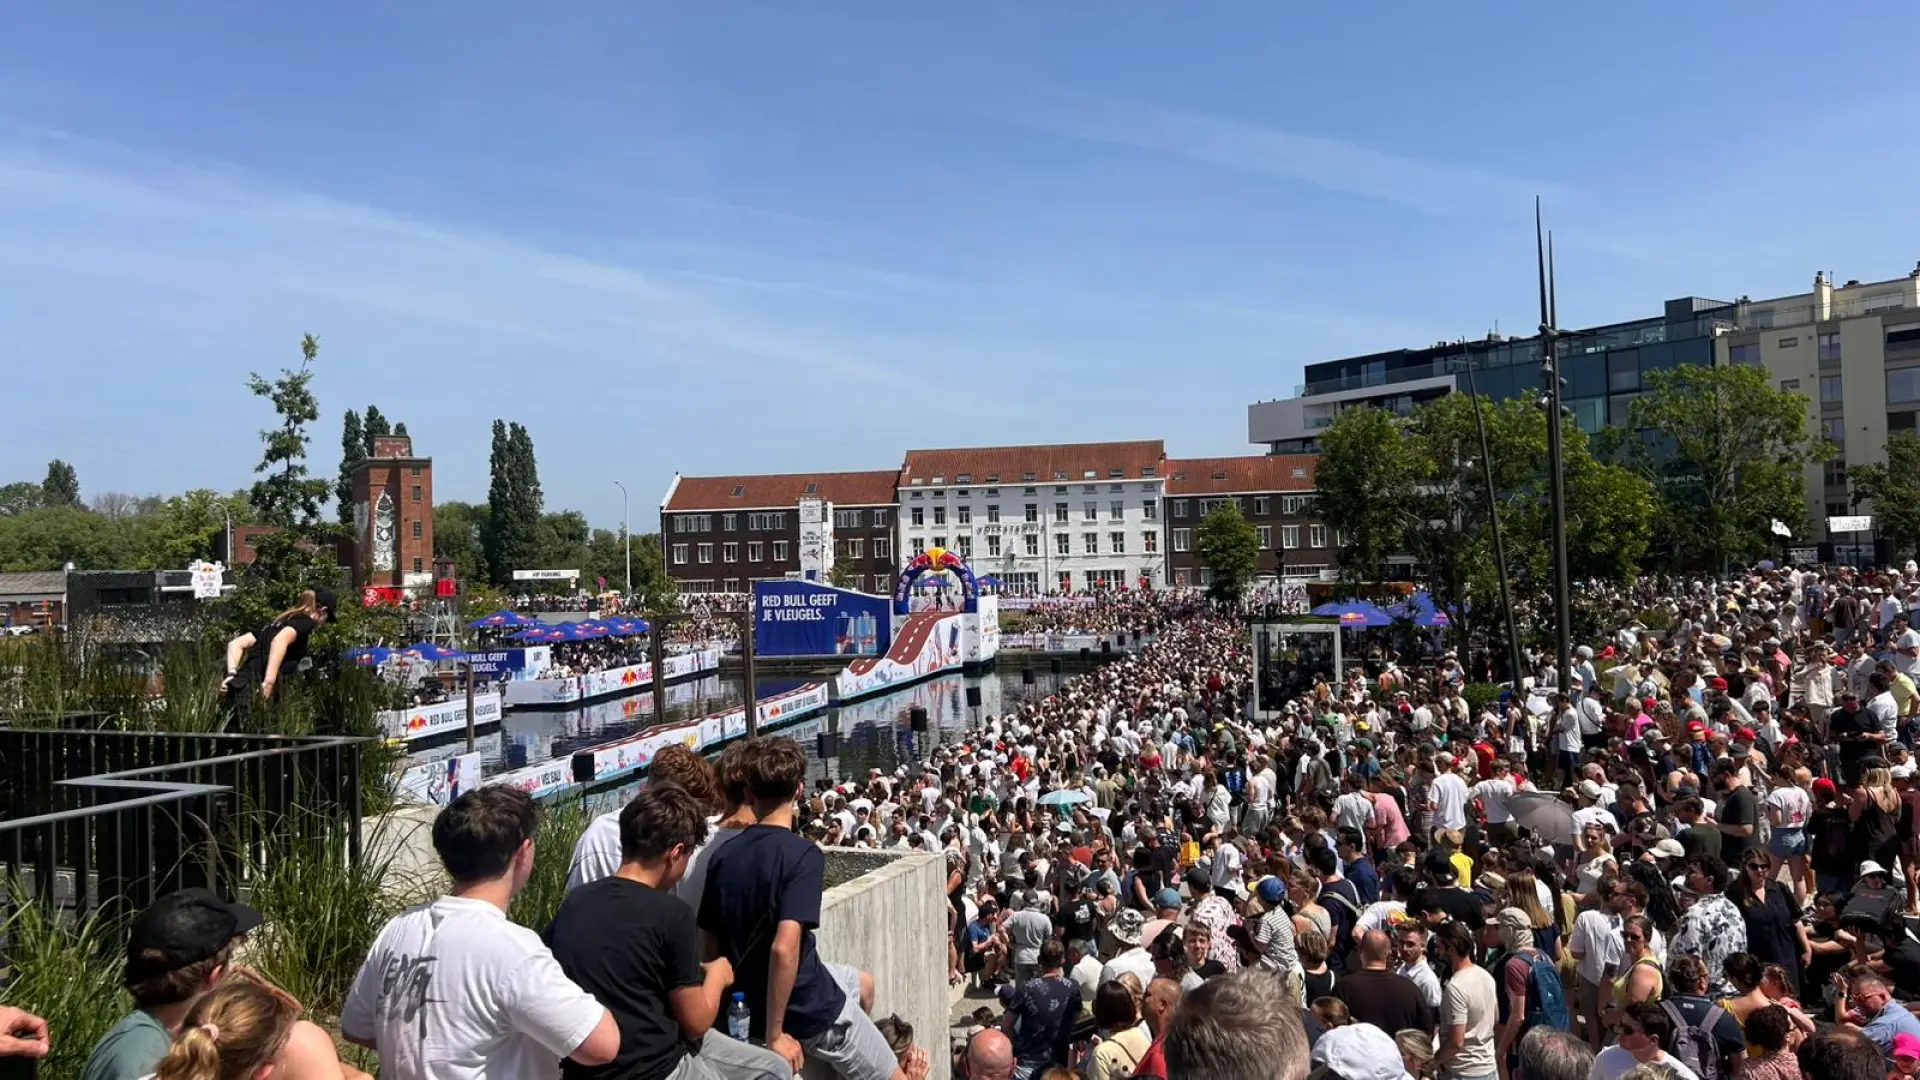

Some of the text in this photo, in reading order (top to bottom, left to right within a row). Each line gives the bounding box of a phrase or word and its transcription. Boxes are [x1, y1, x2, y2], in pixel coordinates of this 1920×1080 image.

[762, 593, 838, 607] RED BULL GEEFT
[762, 608, 825, 621] JE VLEUGELS.
